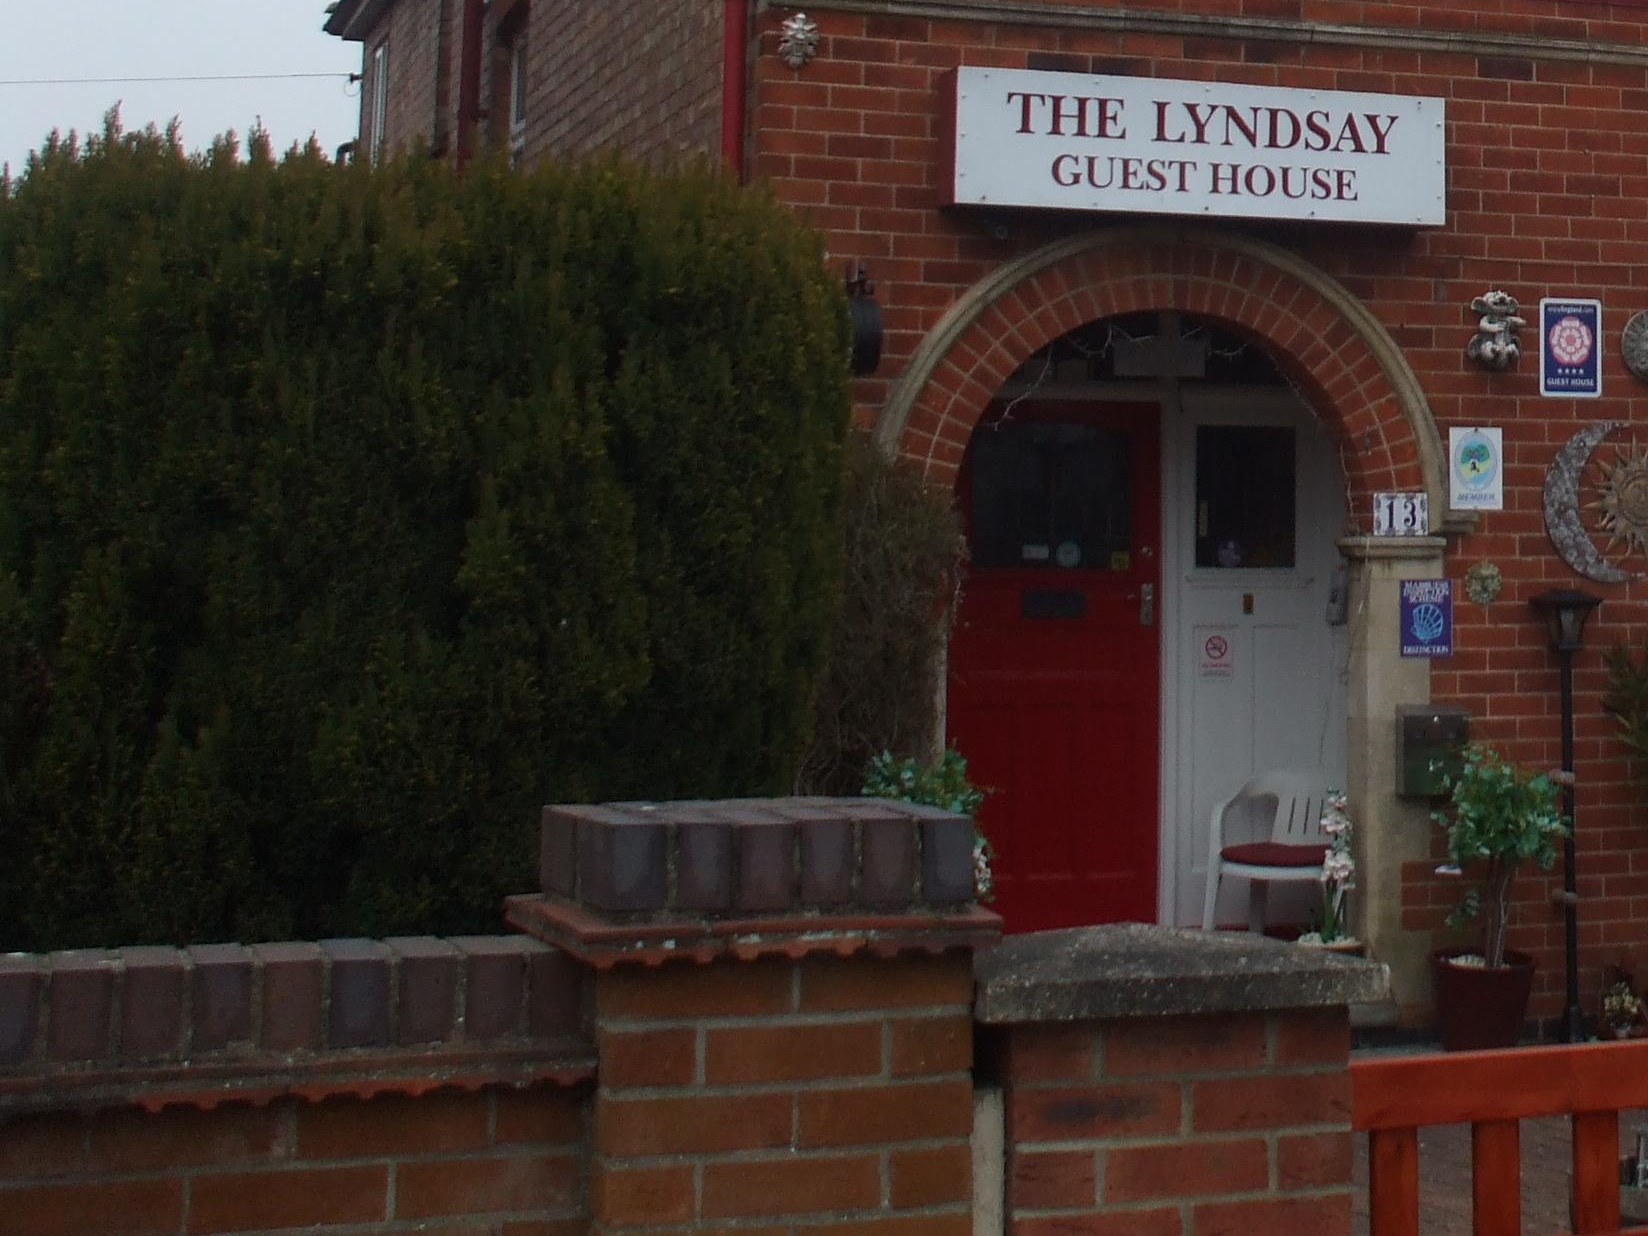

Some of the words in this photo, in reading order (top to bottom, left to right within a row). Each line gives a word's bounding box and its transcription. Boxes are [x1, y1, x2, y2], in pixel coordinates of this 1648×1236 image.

[1007, 91, 1127, 140] THE
[1151, 100, 1399, 156] LYNDSAY
[1051, 153, 1198, 193] GUEST
[1208, 163, 1359, 202] HOUSE
[1386, 500, 1416, 528] 13
